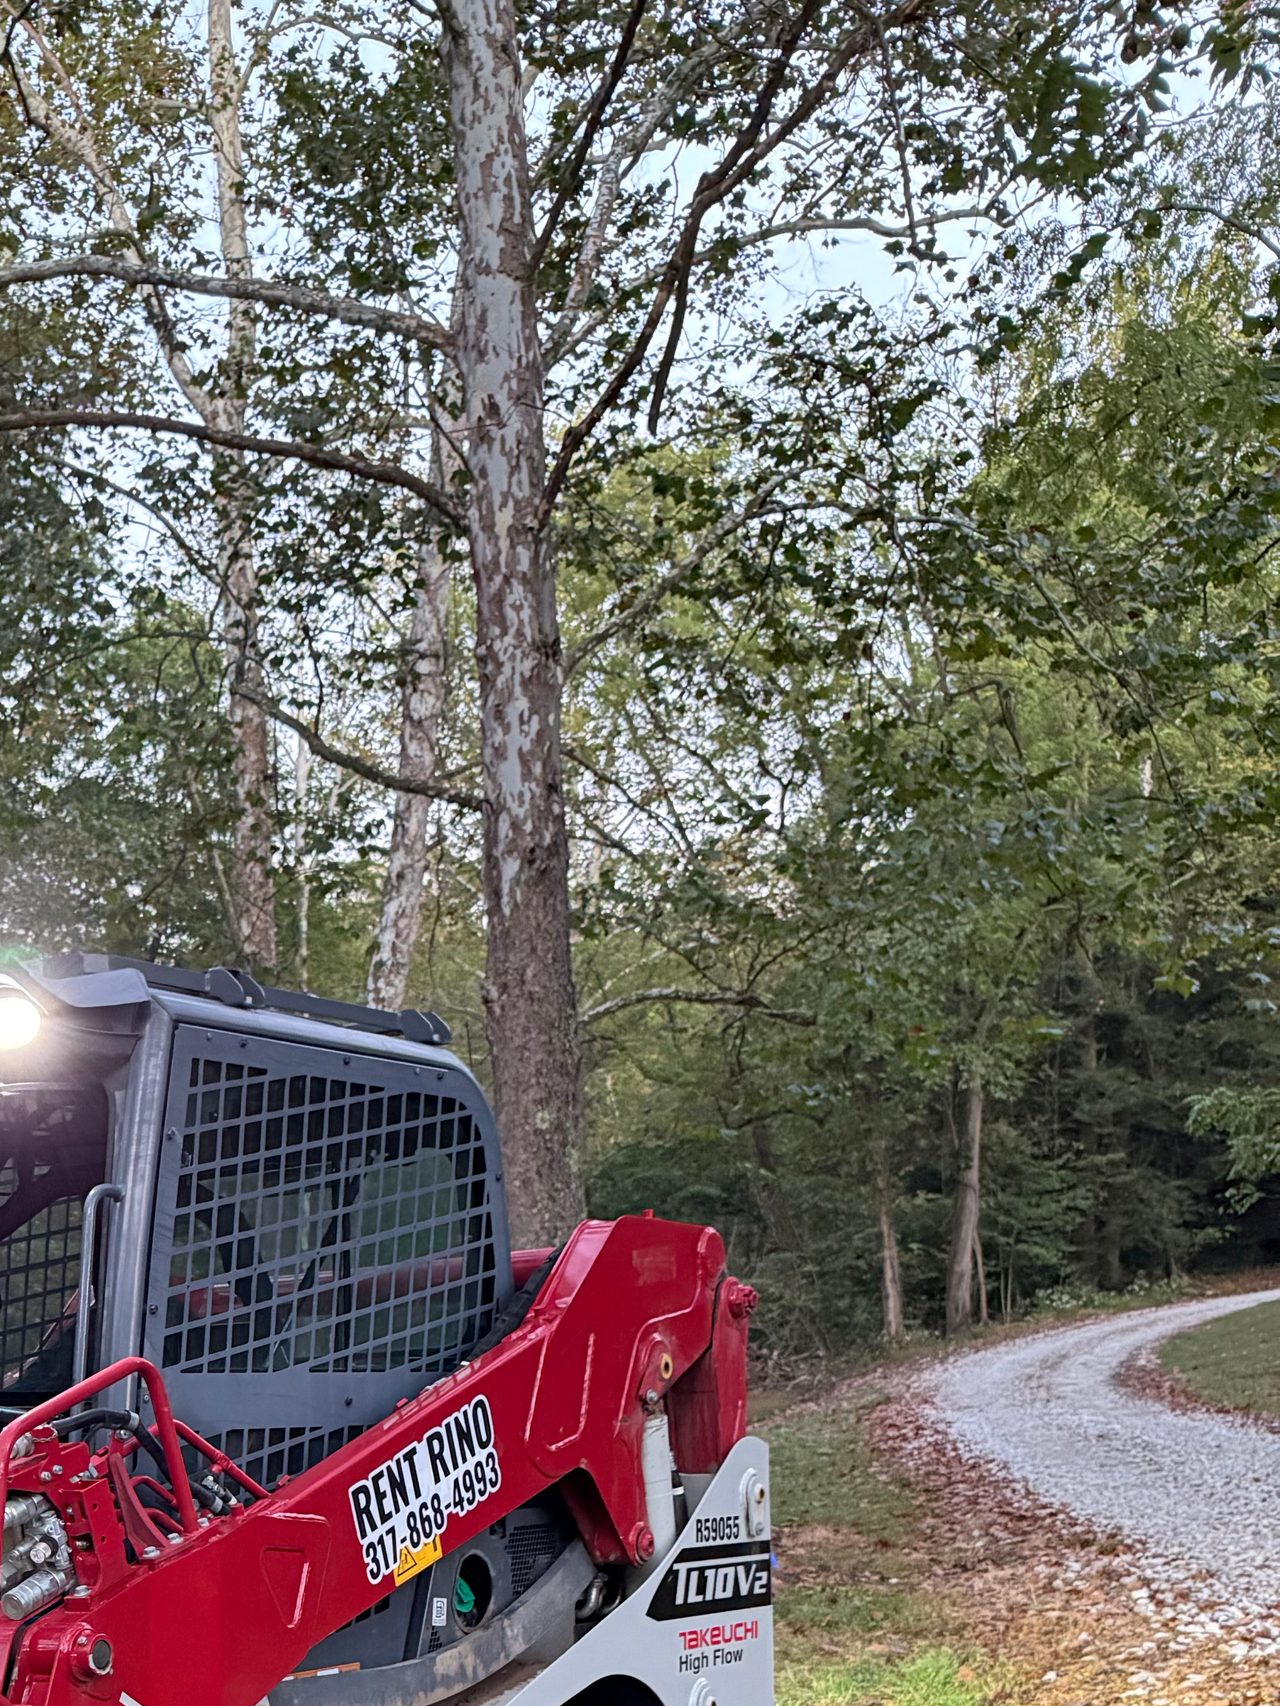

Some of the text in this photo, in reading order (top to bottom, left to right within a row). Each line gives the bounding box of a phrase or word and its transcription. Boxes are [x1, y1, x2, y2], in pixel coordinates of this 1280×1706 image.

[351, 1399, 492, 1540] RENT RINO
[365, 1452, 499, 1581] 317-868-4993
[696, 1516, 740, 1543] R59055
[672, 1553, 770, 1606] TL10V2
[679, 1620, 758, 1650] TAKEUCHI
[679, 1648, 744, 1674] High Flow
